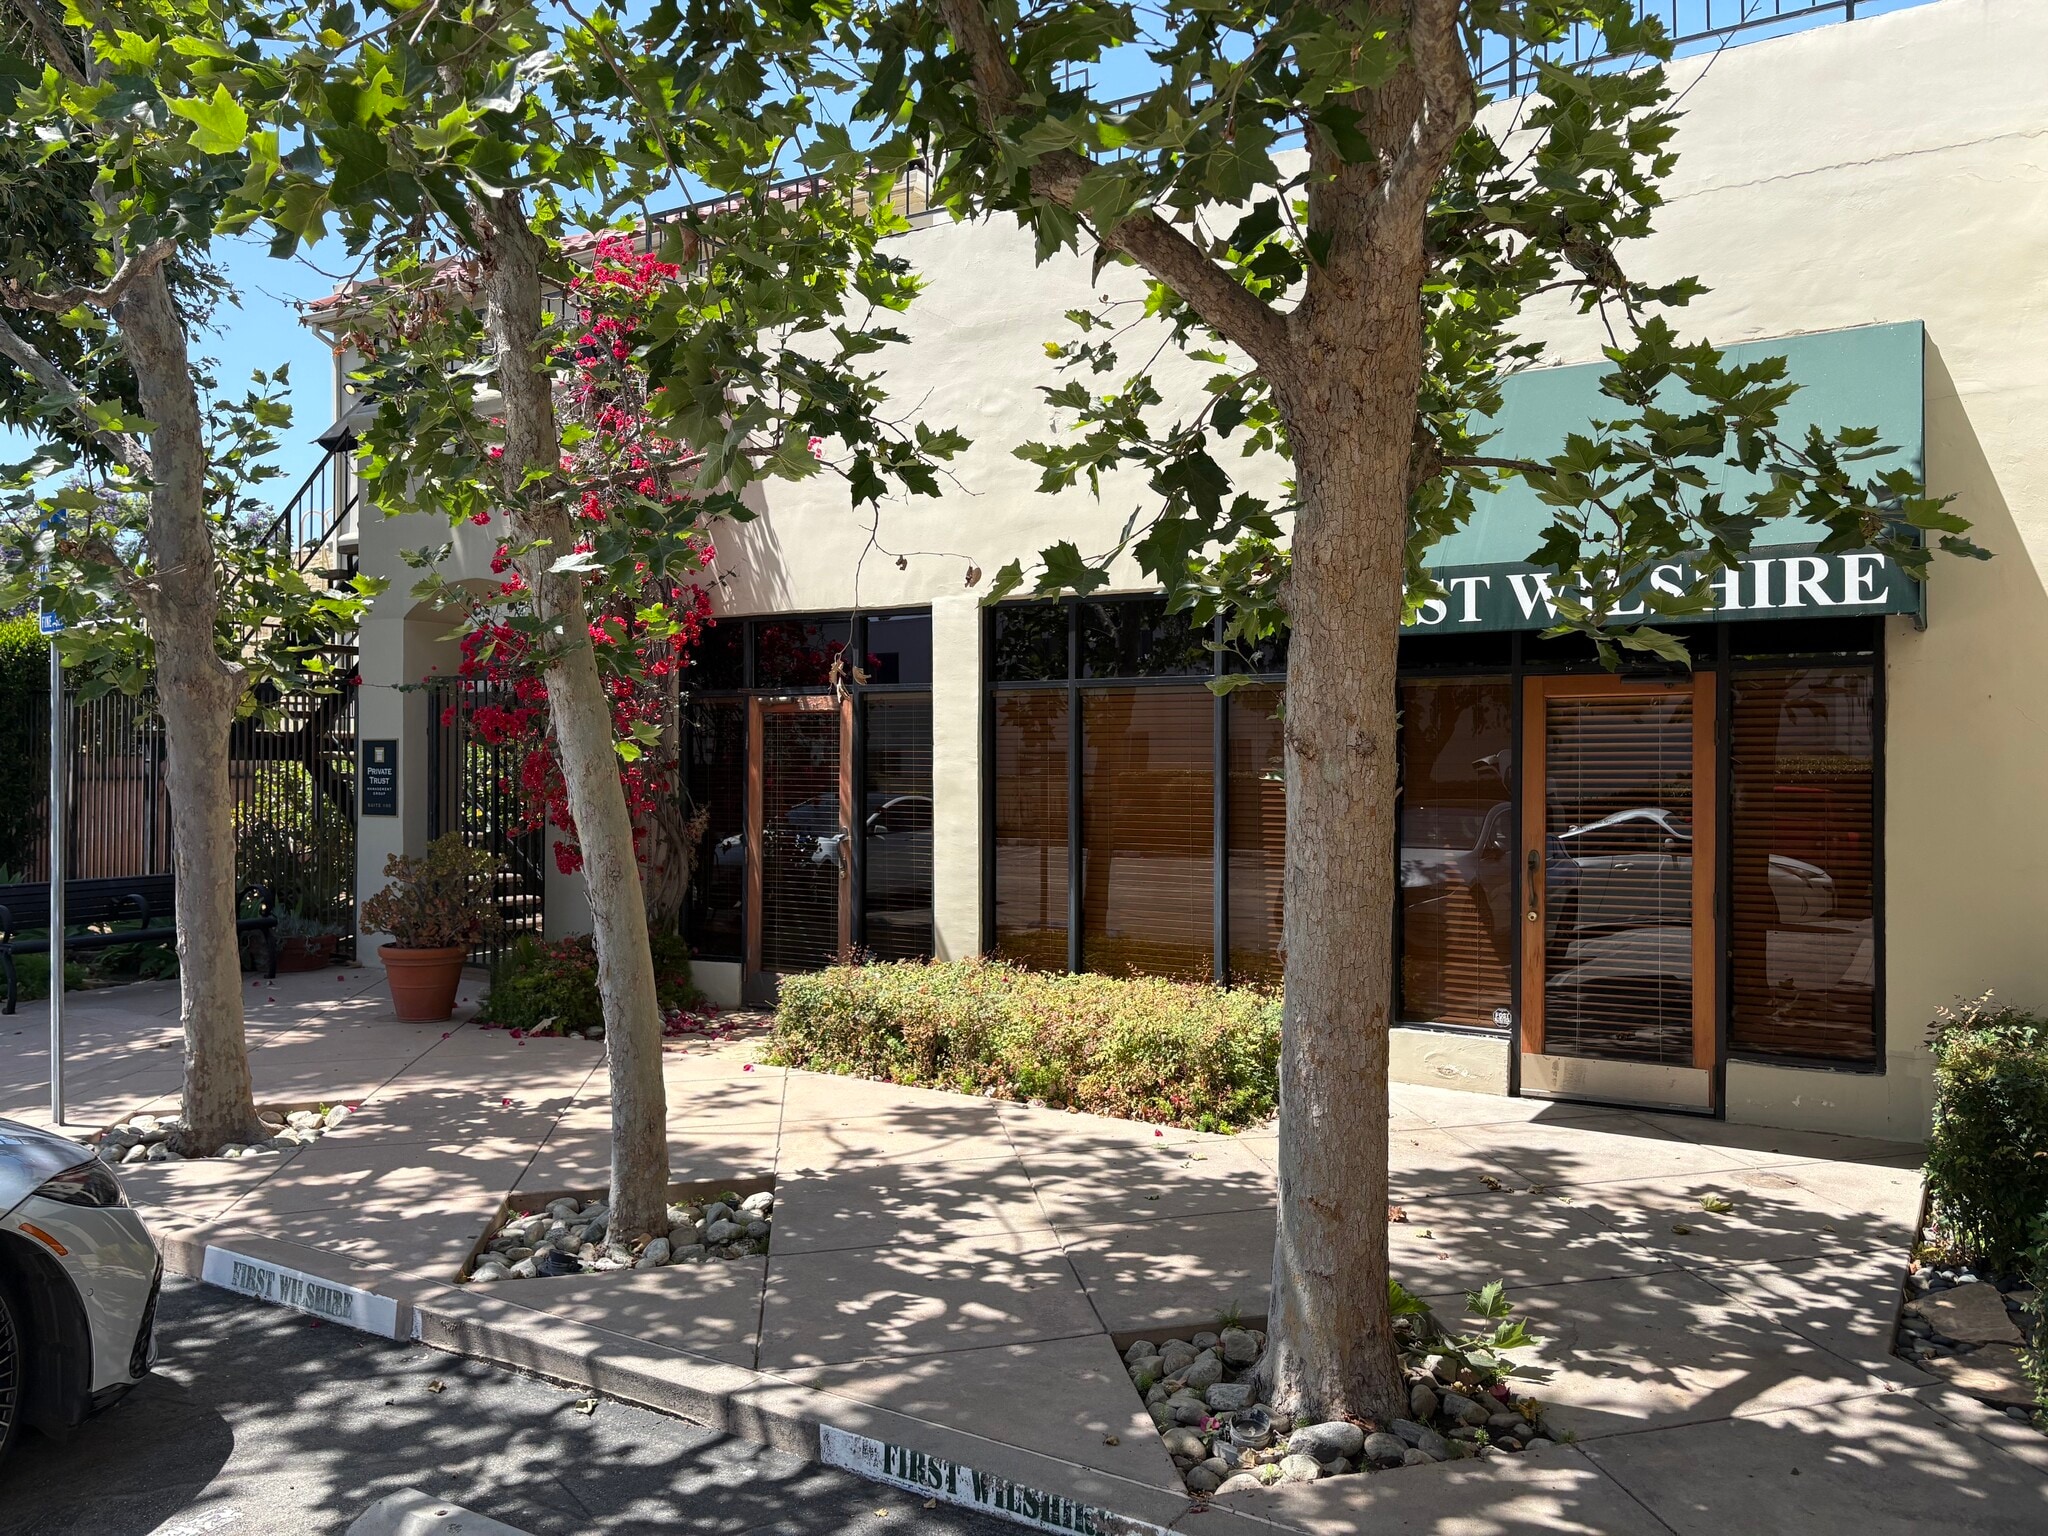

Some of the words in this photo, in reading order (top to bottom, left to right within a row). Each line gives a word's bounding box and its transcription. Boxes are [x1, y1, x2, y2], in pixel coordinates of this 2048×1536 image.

[367, 767, 392, 775] PRIVATE
[369, 776, 390, 784] TRUST
[231, 1261, 275, 1297] FIRST
[279, 1274, 354, 1320] WILSHIRE
[883, 1442, 961, 1495] FIRST
